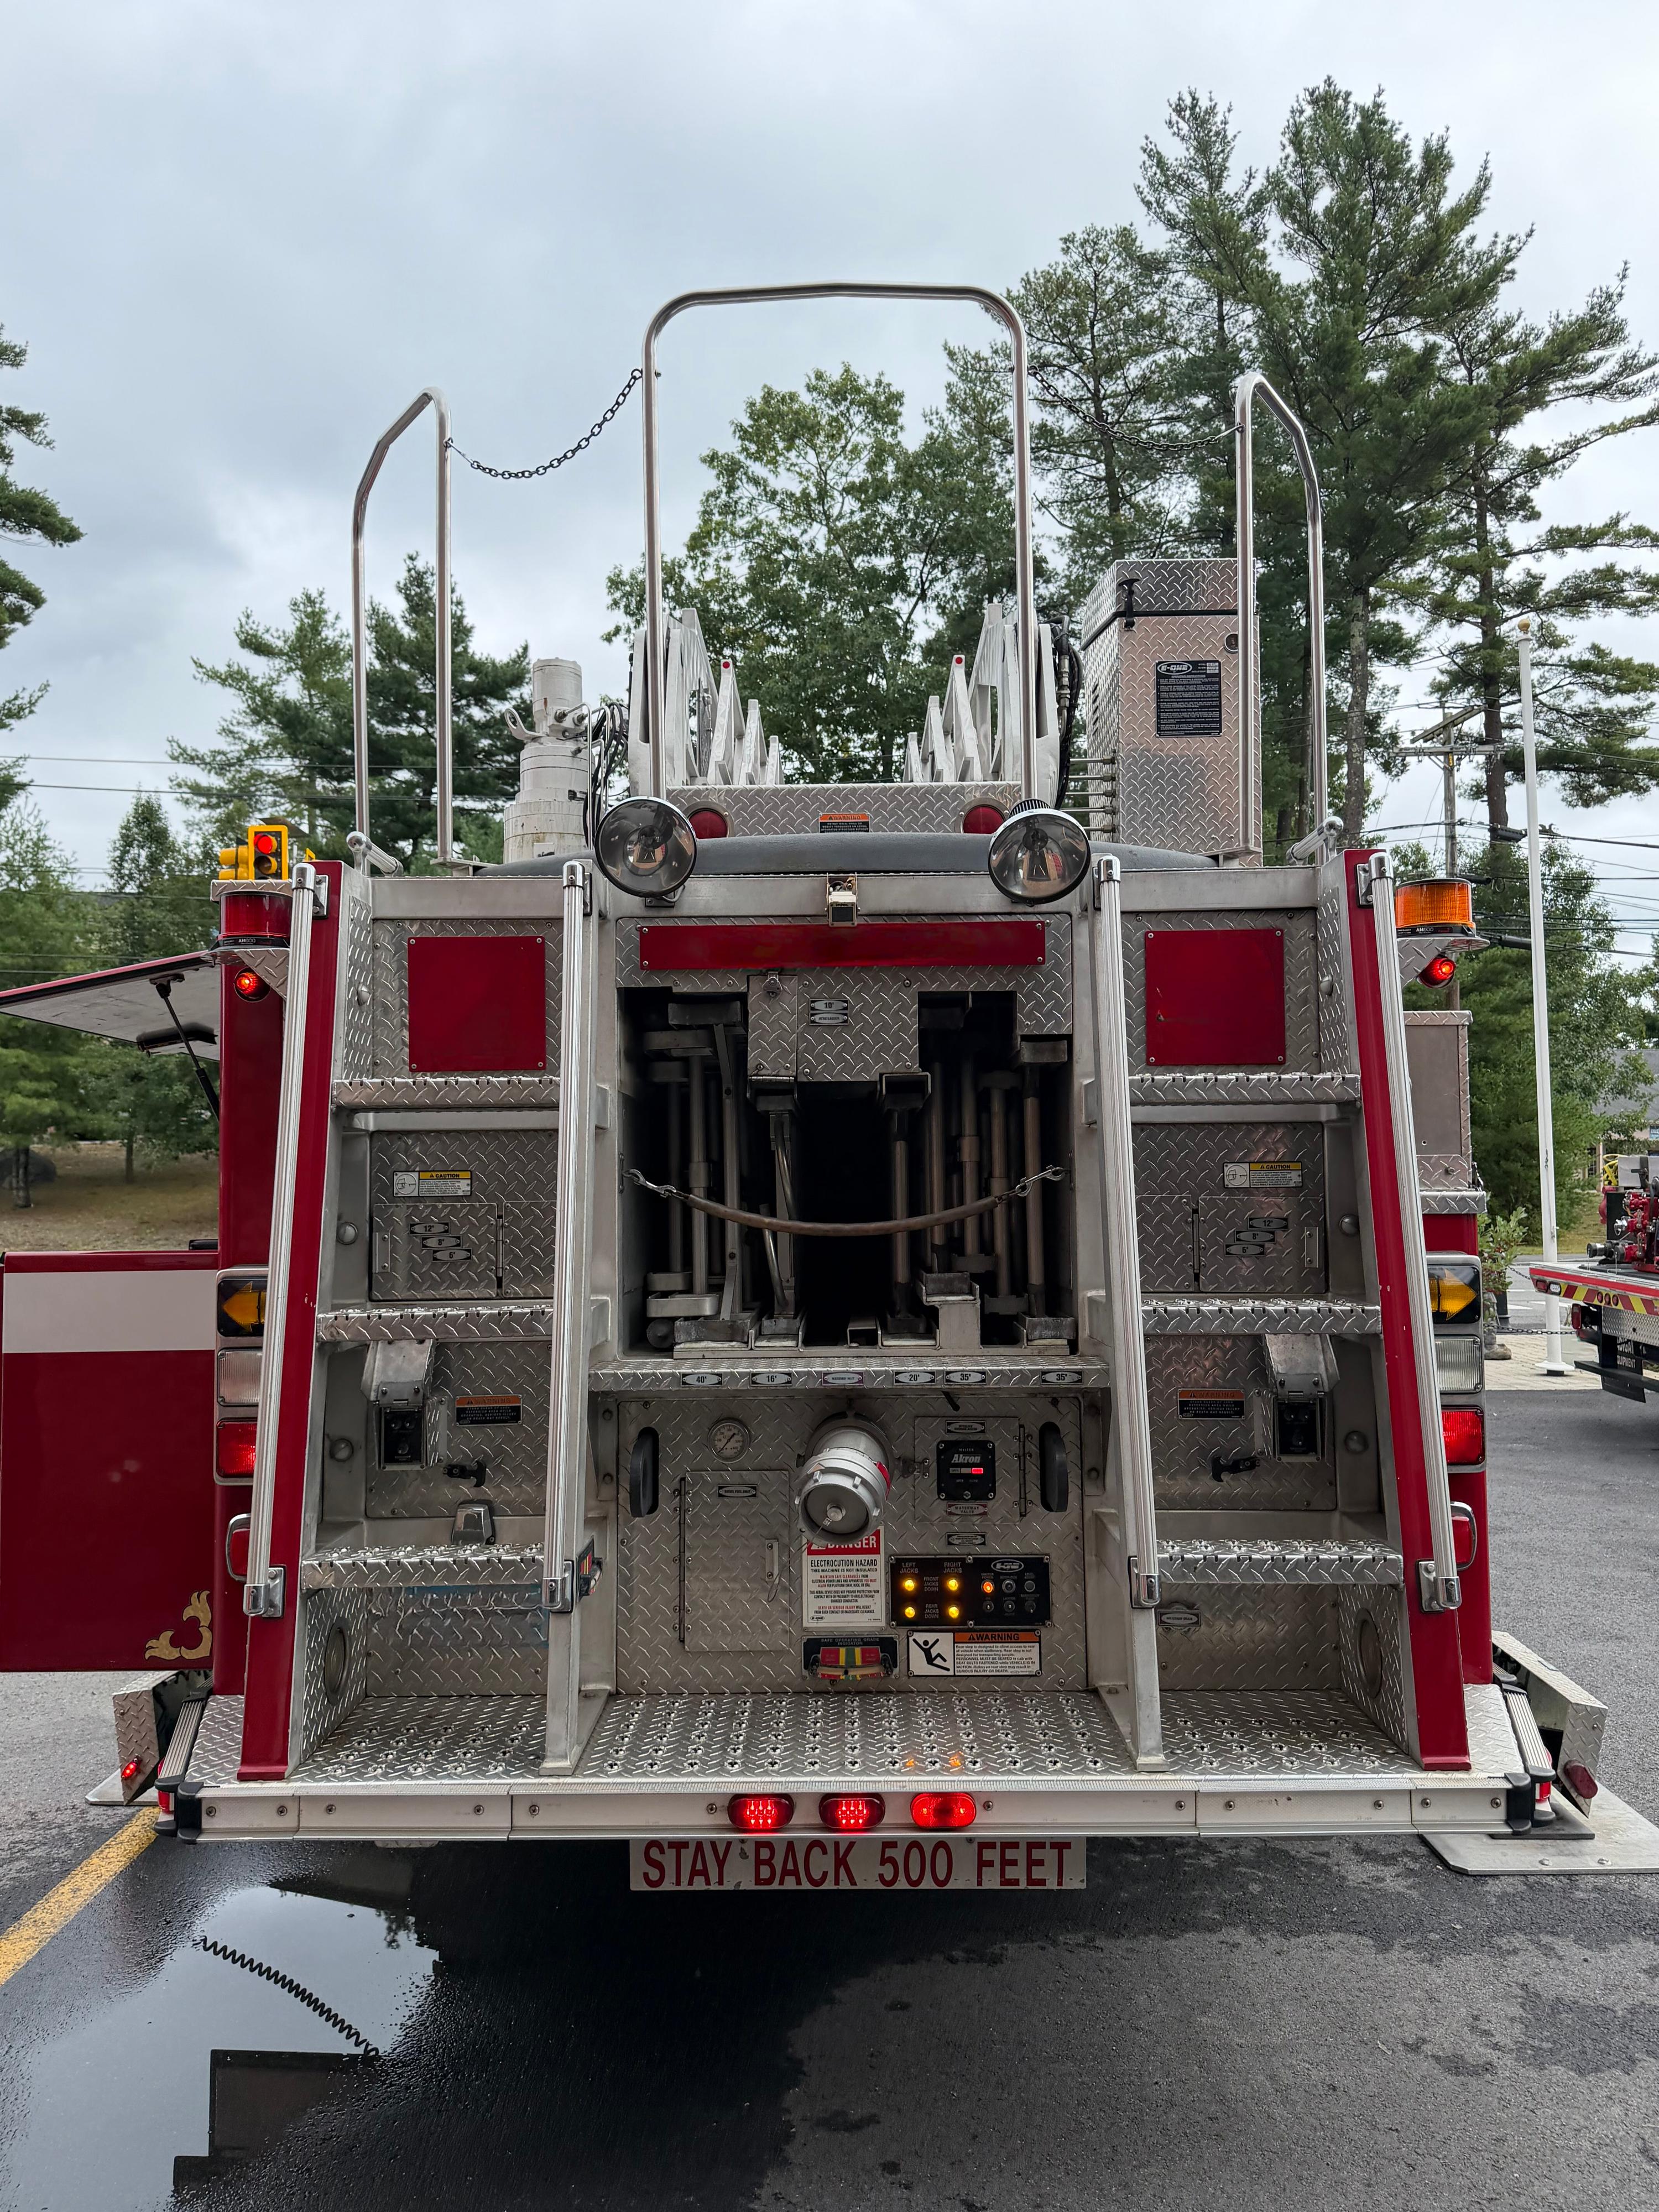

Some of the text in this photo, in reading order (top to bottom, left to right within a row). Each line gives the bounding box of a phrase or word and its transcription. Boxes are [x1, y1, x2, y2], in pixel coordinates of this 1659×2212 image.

[951, 1454, 981, 1463] Akron
[643, 1840, 1072, 1888] STAY BACK 500 FEET
